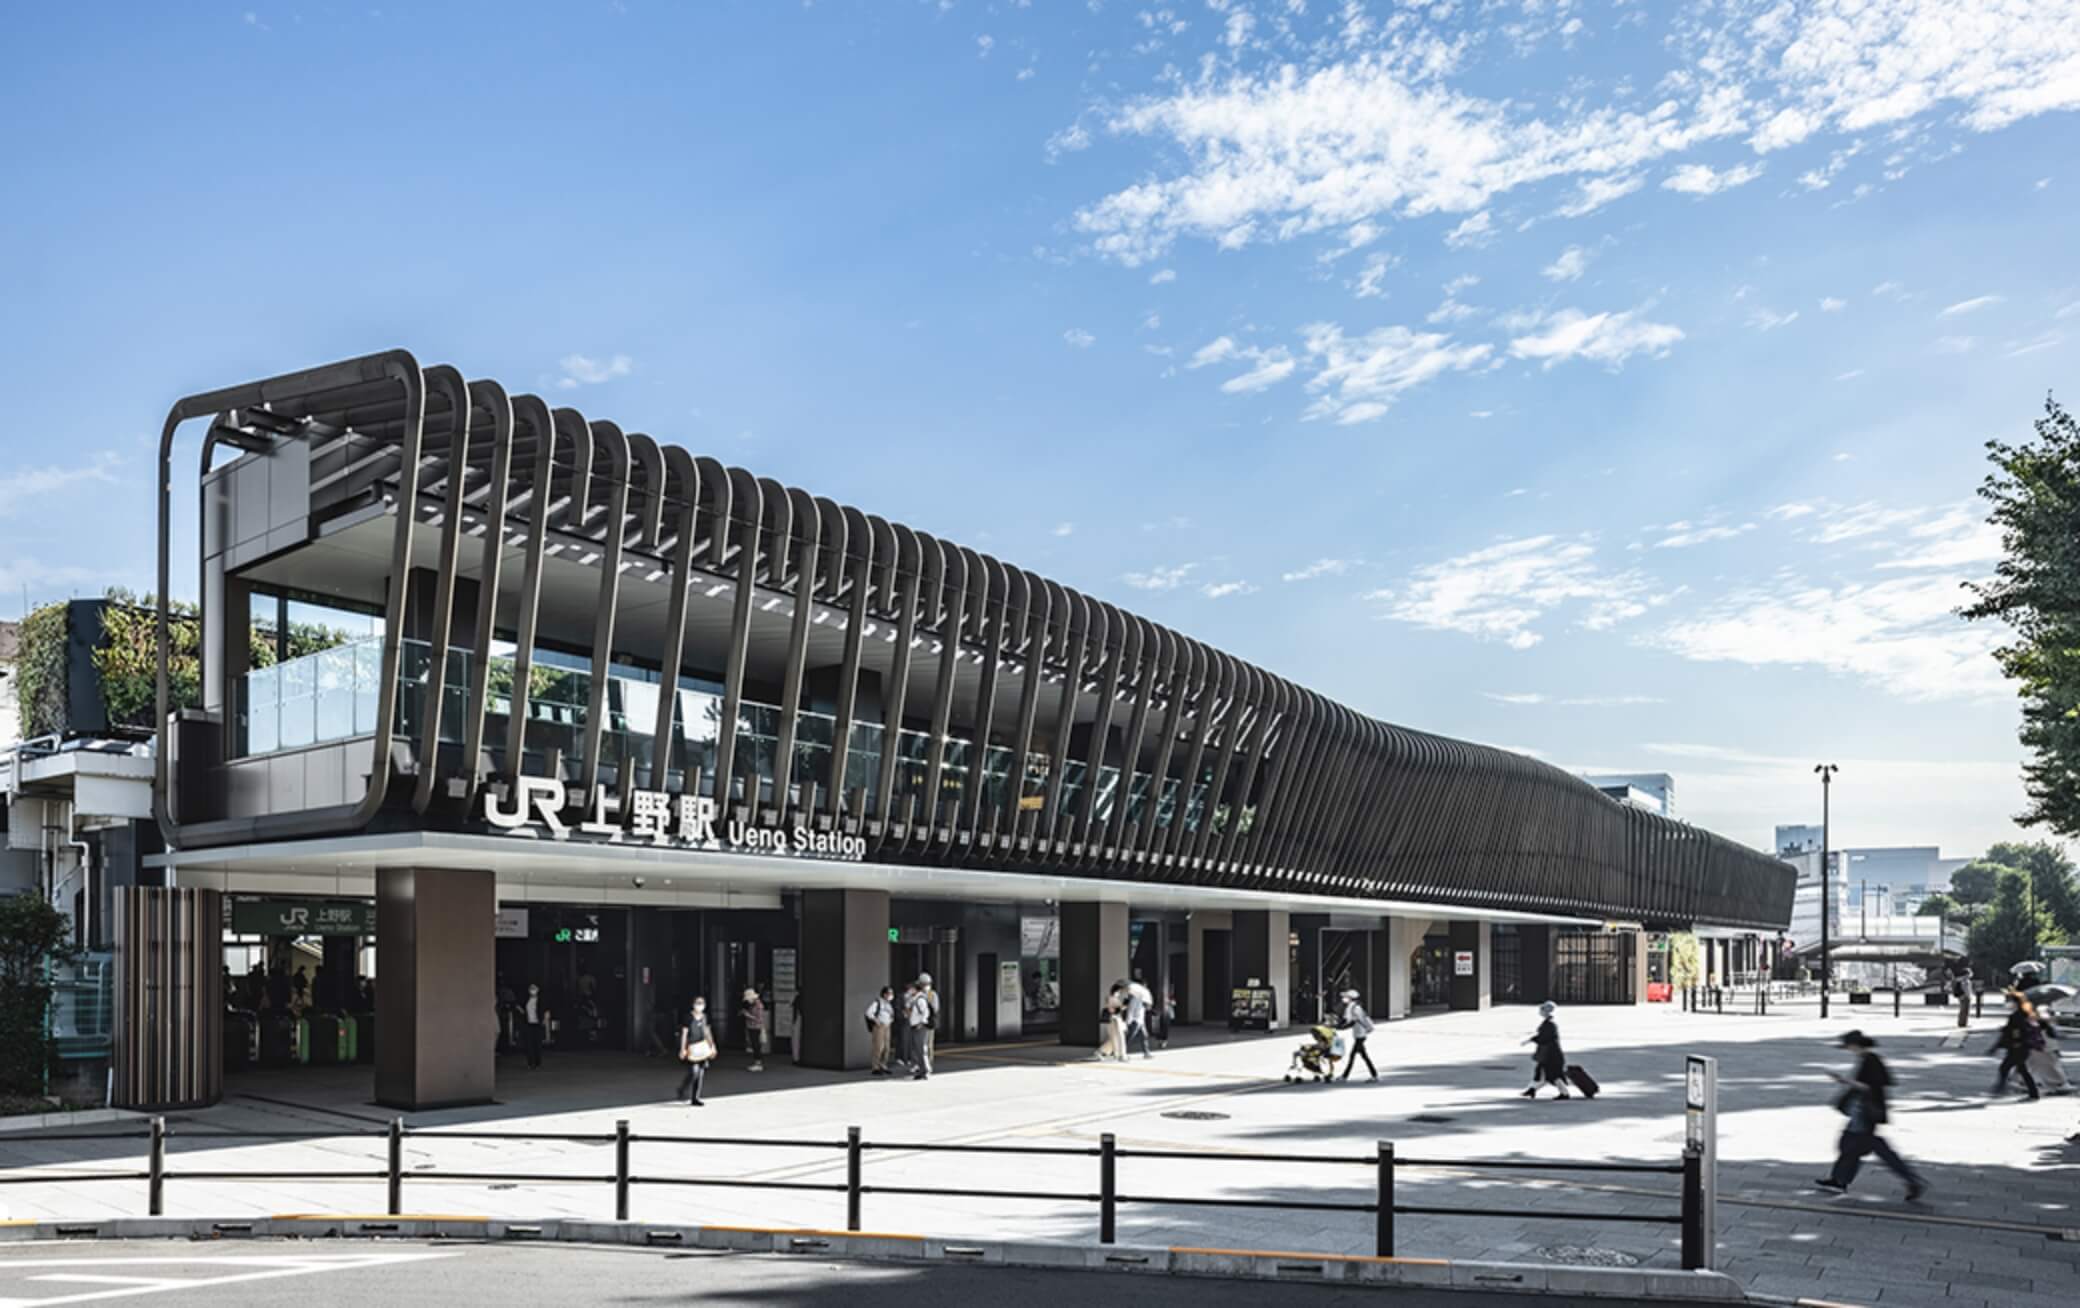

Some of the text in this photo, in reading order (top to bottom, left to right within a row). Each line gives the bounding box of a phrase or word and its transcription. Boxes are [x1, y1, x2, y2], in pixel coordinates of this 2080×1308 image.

[728, 820, 867, 856] Ueno Station
[279, 907, 310, 925] JR
[555, 927, 571, 943] JR
